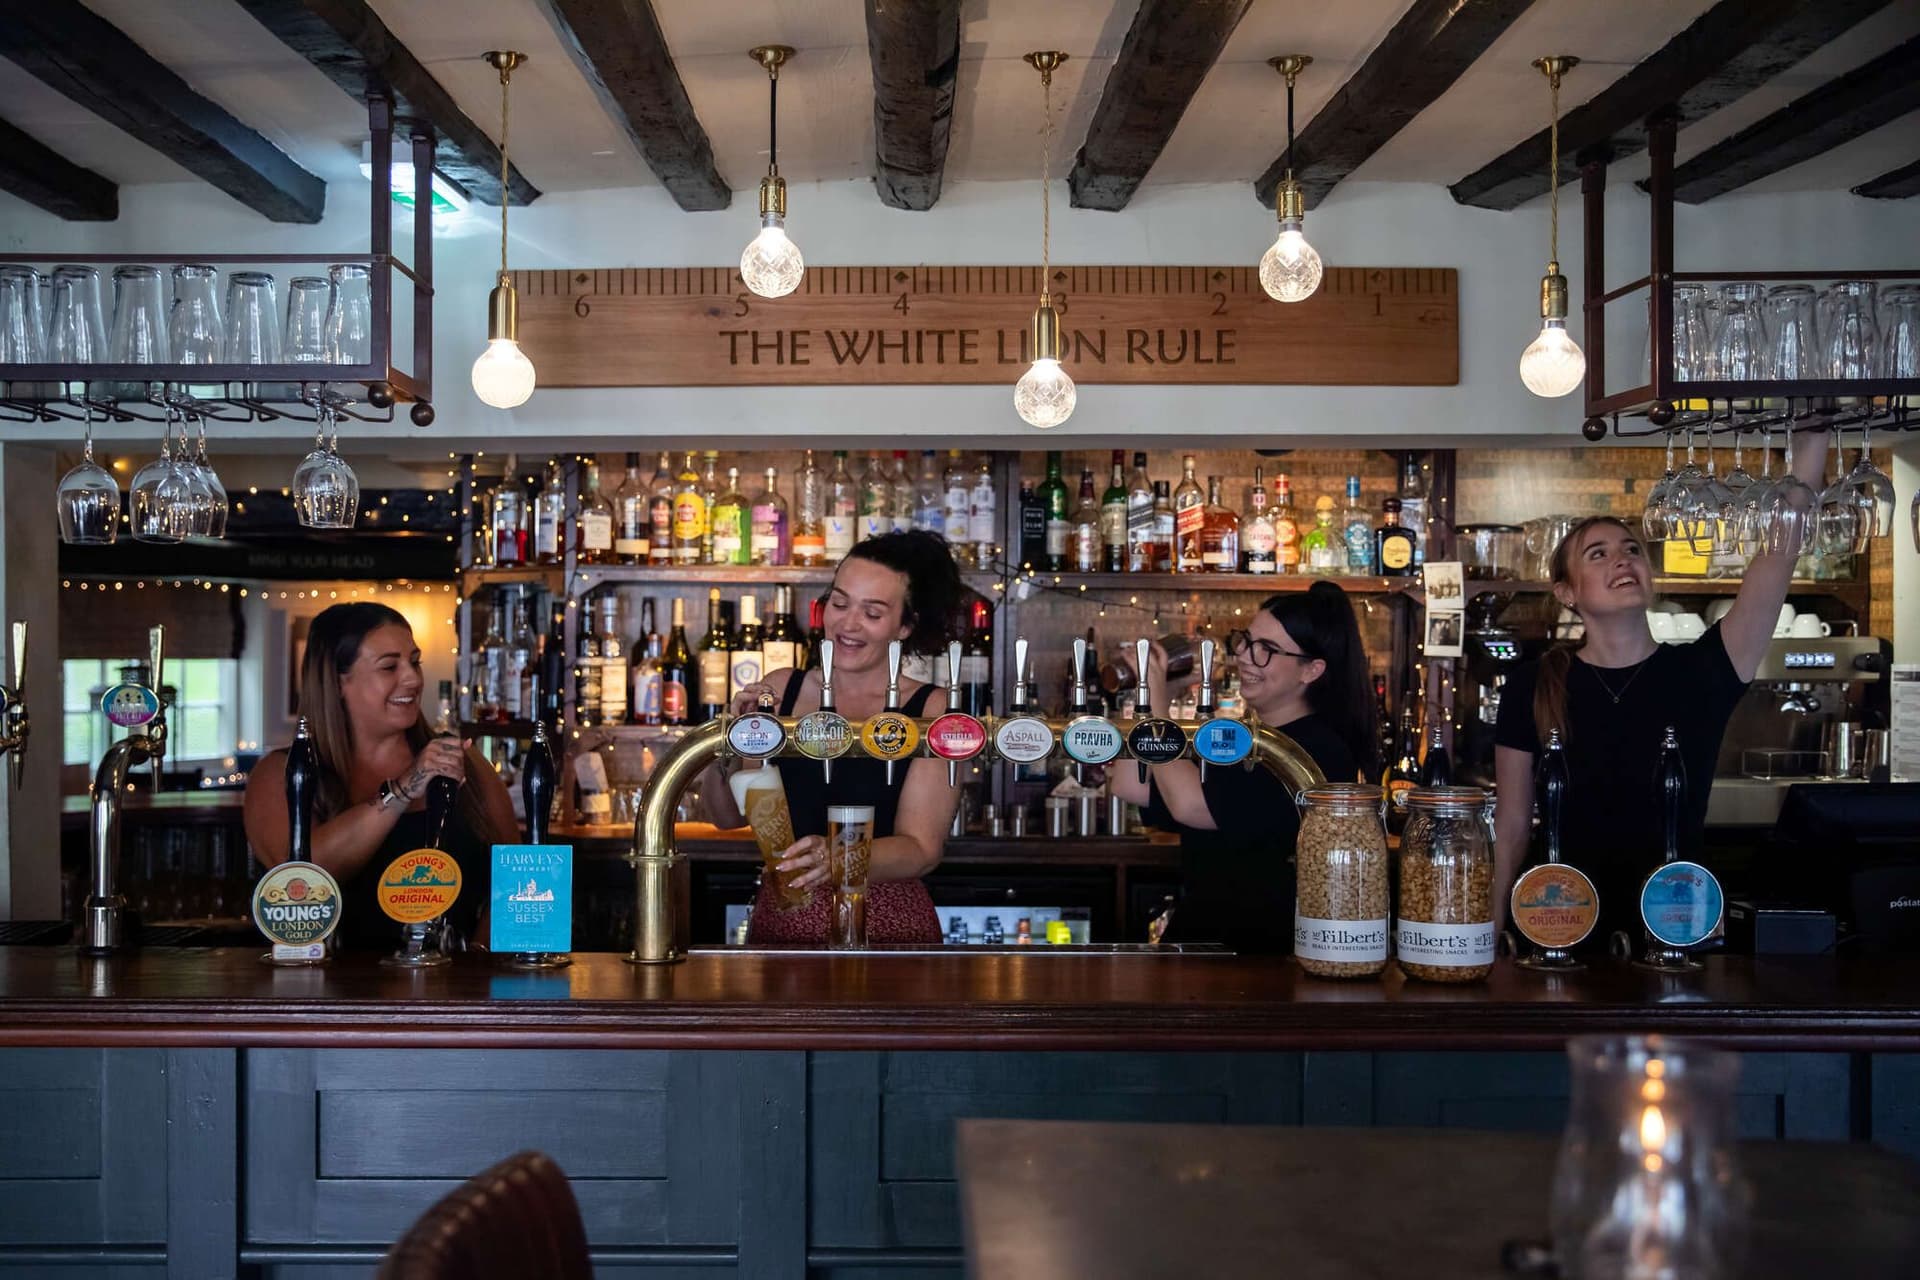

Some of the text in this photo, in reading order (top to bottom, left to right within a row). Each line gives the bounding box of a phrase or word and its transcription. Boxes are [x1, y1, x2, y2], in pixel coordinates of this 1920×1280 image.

[574, 293, 1384, 318] 6 5 4 3 2 1
[719, 328, 1237, 366] THE WHITE LIN RULE
[799, 726, 845, 741] NECK OIL
[1005, 730, 1044, 742] ASPALL
[1074, 732, 1113, 746] PRAVHA
[1137, 742, 1180, 752] GUINNESS
[401, 856, 447, 870] YOUNG'S
[389, 894, 445, 904] ORIGINAL
[263, 904, 332, 922] YOUNG'S
[507, 902, 554, 913] SUSSEX
[515, 913, 546, 923] BEST
[1528, 915, 1584, 925] ORIGINAL
[272, 921, 324, 931] LONDON
[285, 931, 312, 939] GOLD
[1321, 929, 1385, 944] Filbert's
[1402, 931, 1468, 948] Filbert's
